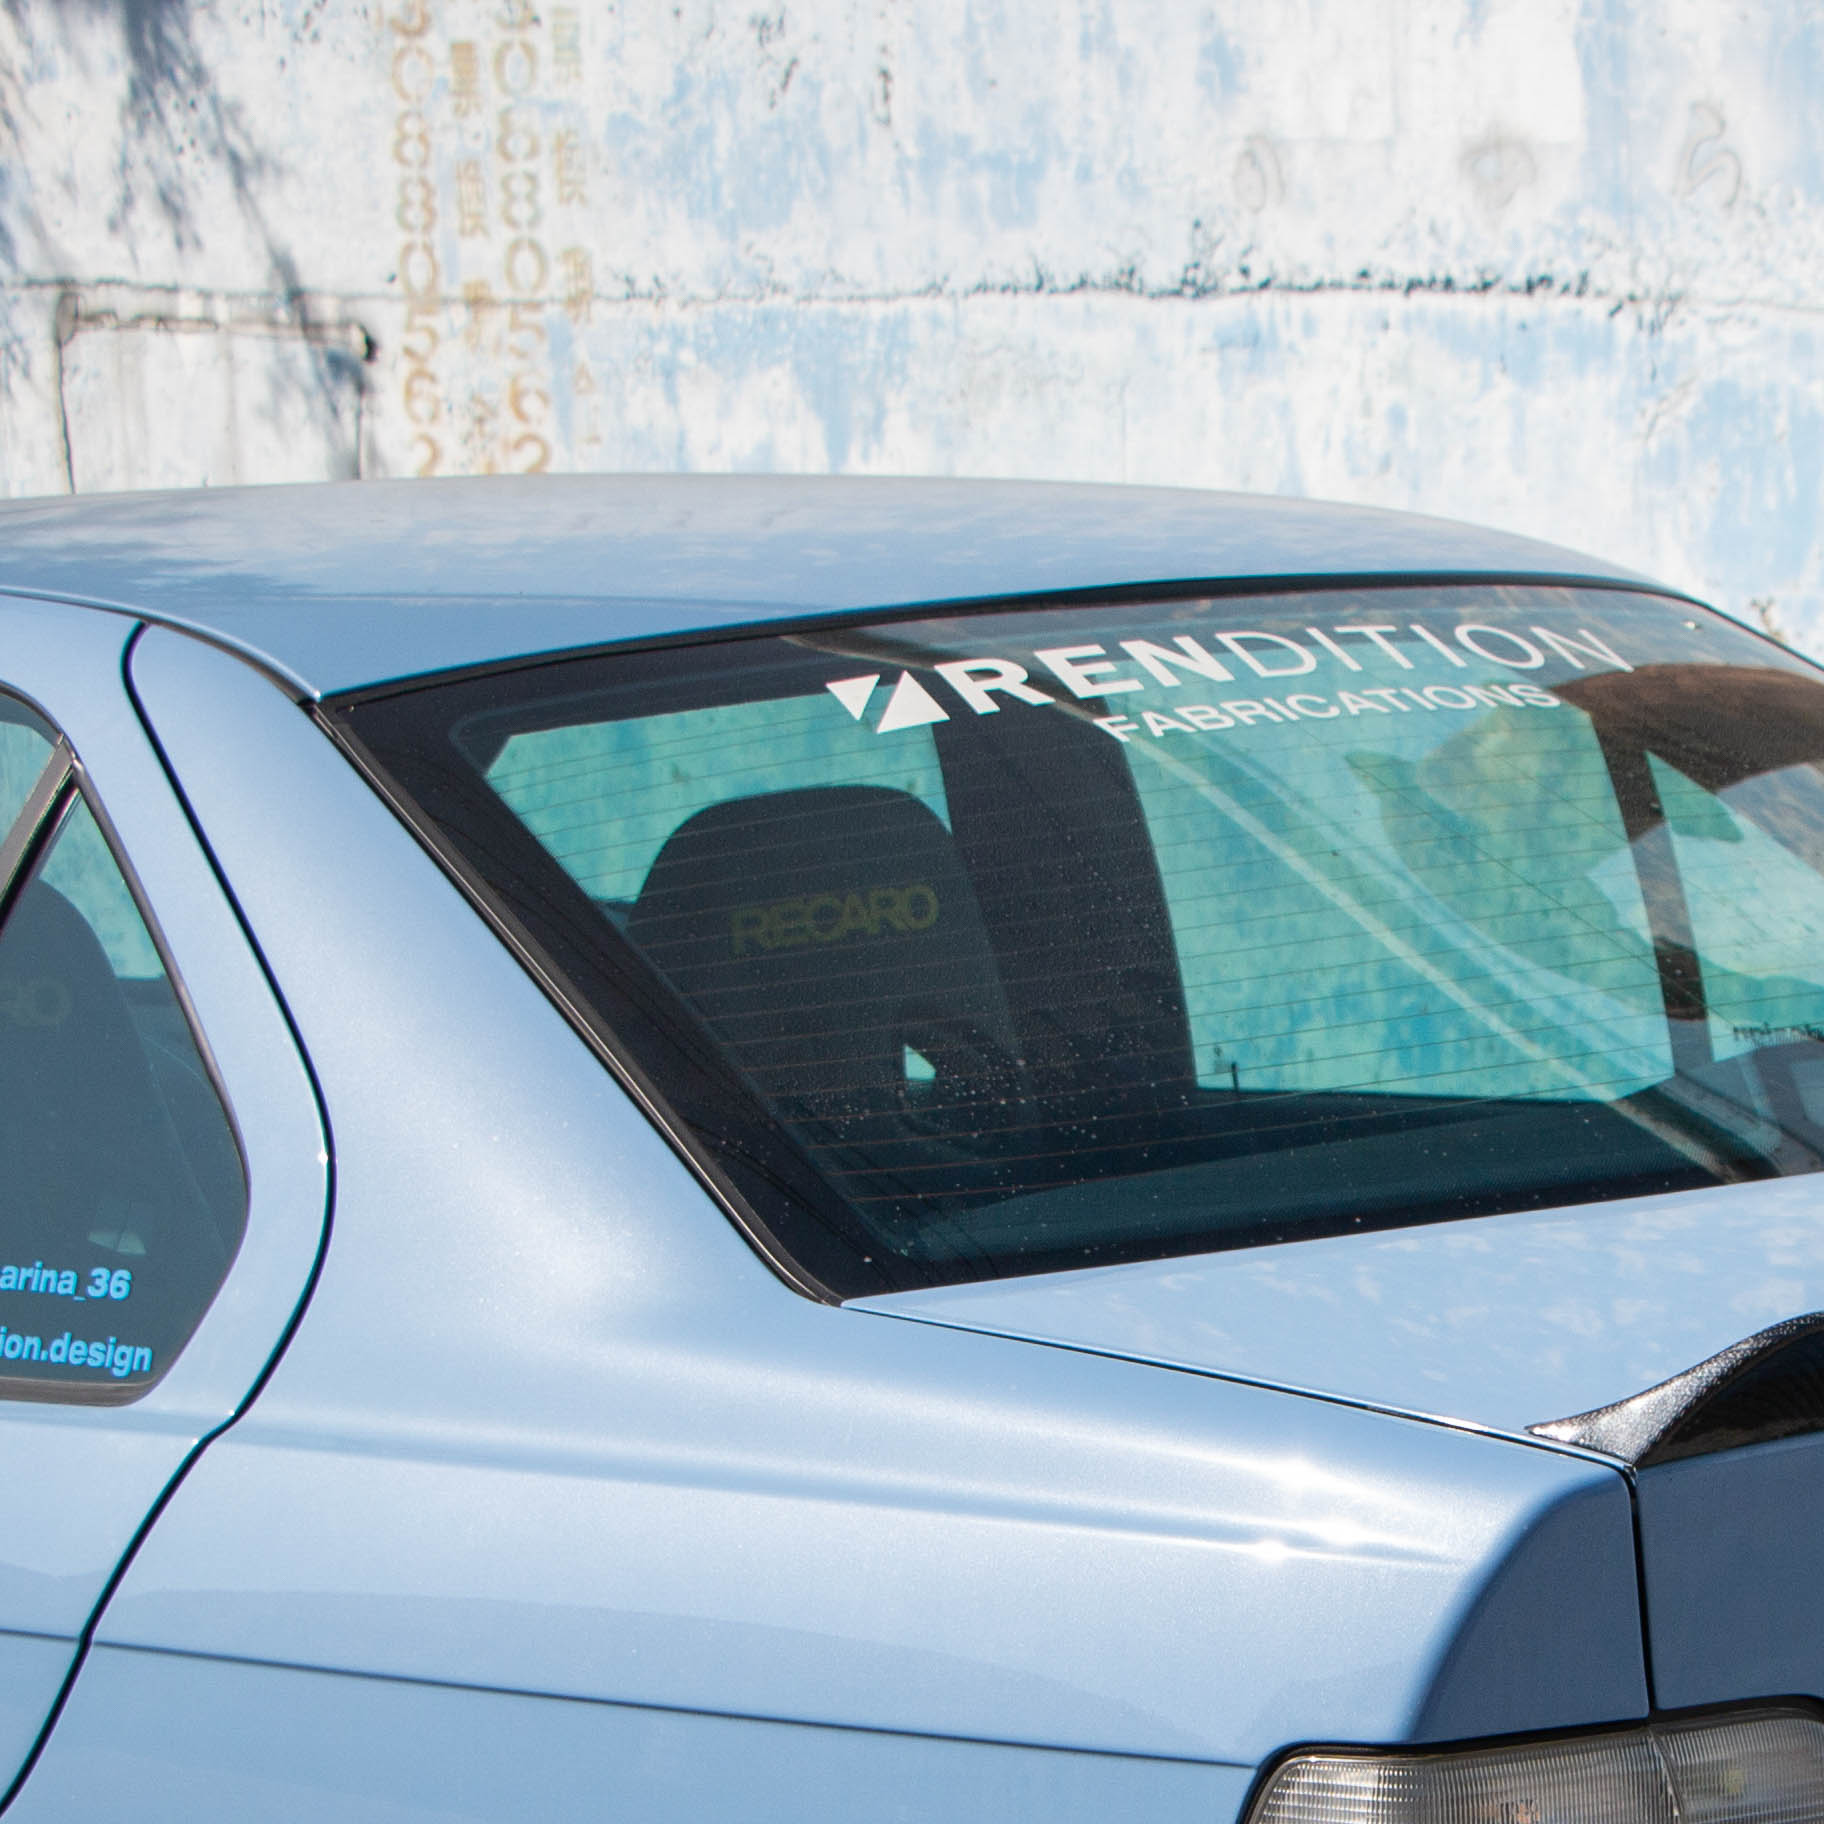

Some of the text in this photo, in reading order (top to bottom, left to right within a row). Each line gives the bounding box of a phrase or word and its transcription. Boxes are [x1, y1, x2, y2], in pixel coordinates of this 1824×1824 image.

[934, 623, 1635, 715] RENDITION
[1092, 683, 1562, 743] FABRICATIONS
[730, 884, 939, 955] RECARO
[0, 1260, 132, 1301] arina_36
